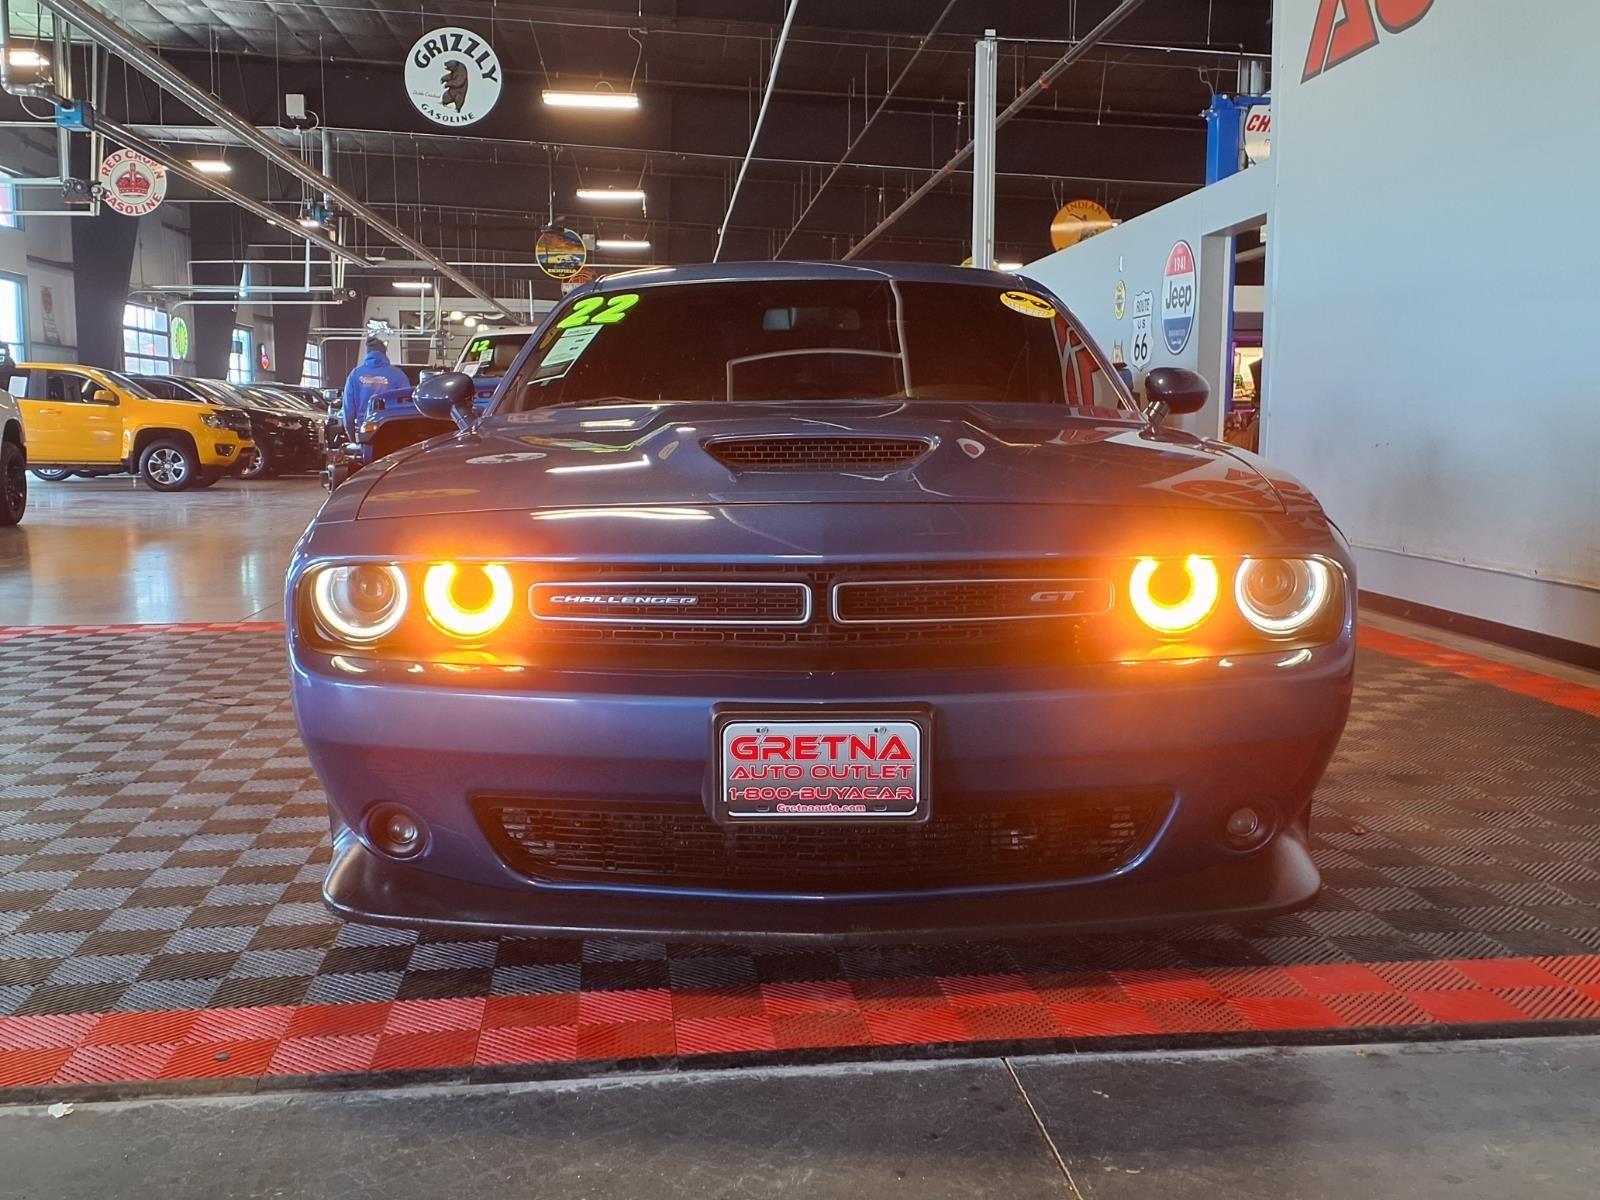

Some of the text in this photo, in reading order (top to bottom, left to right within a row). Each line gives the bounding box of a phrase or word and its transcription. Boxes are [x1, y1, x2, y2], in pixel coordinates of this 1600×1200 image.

[414, 33, 498, 83] GRIZZLY
[421, 103, 475, 123] GASOLINE
[1246, 114, 1271, 132] CH
[101, 153, 122, 177] RED
[104, 189, 162, 215] GASOLINE
[1065, 201, 1103, 215] INDIAN
[1174, 256, 1187, 272] 1941
[1136, 298, 1150, 313] ROUTE
[1165, 280, 1192, 314] Jeep
[556, 294, 639, 328] 22
[471, 339, 491, 353] 12
[1133, 332, 1148, 361] 66
[550, 595, 699, 605] CHALLENGER
[1030, 590, 1086, 602] GT
[729, 734, 914, 761] GRETNA
[729, 764, 914, 780] AUTO OUTLET
[728, 786, 914, 800] 1-800-BUYACAR
[776, 803, 867, 812] Gretnaauto.com
